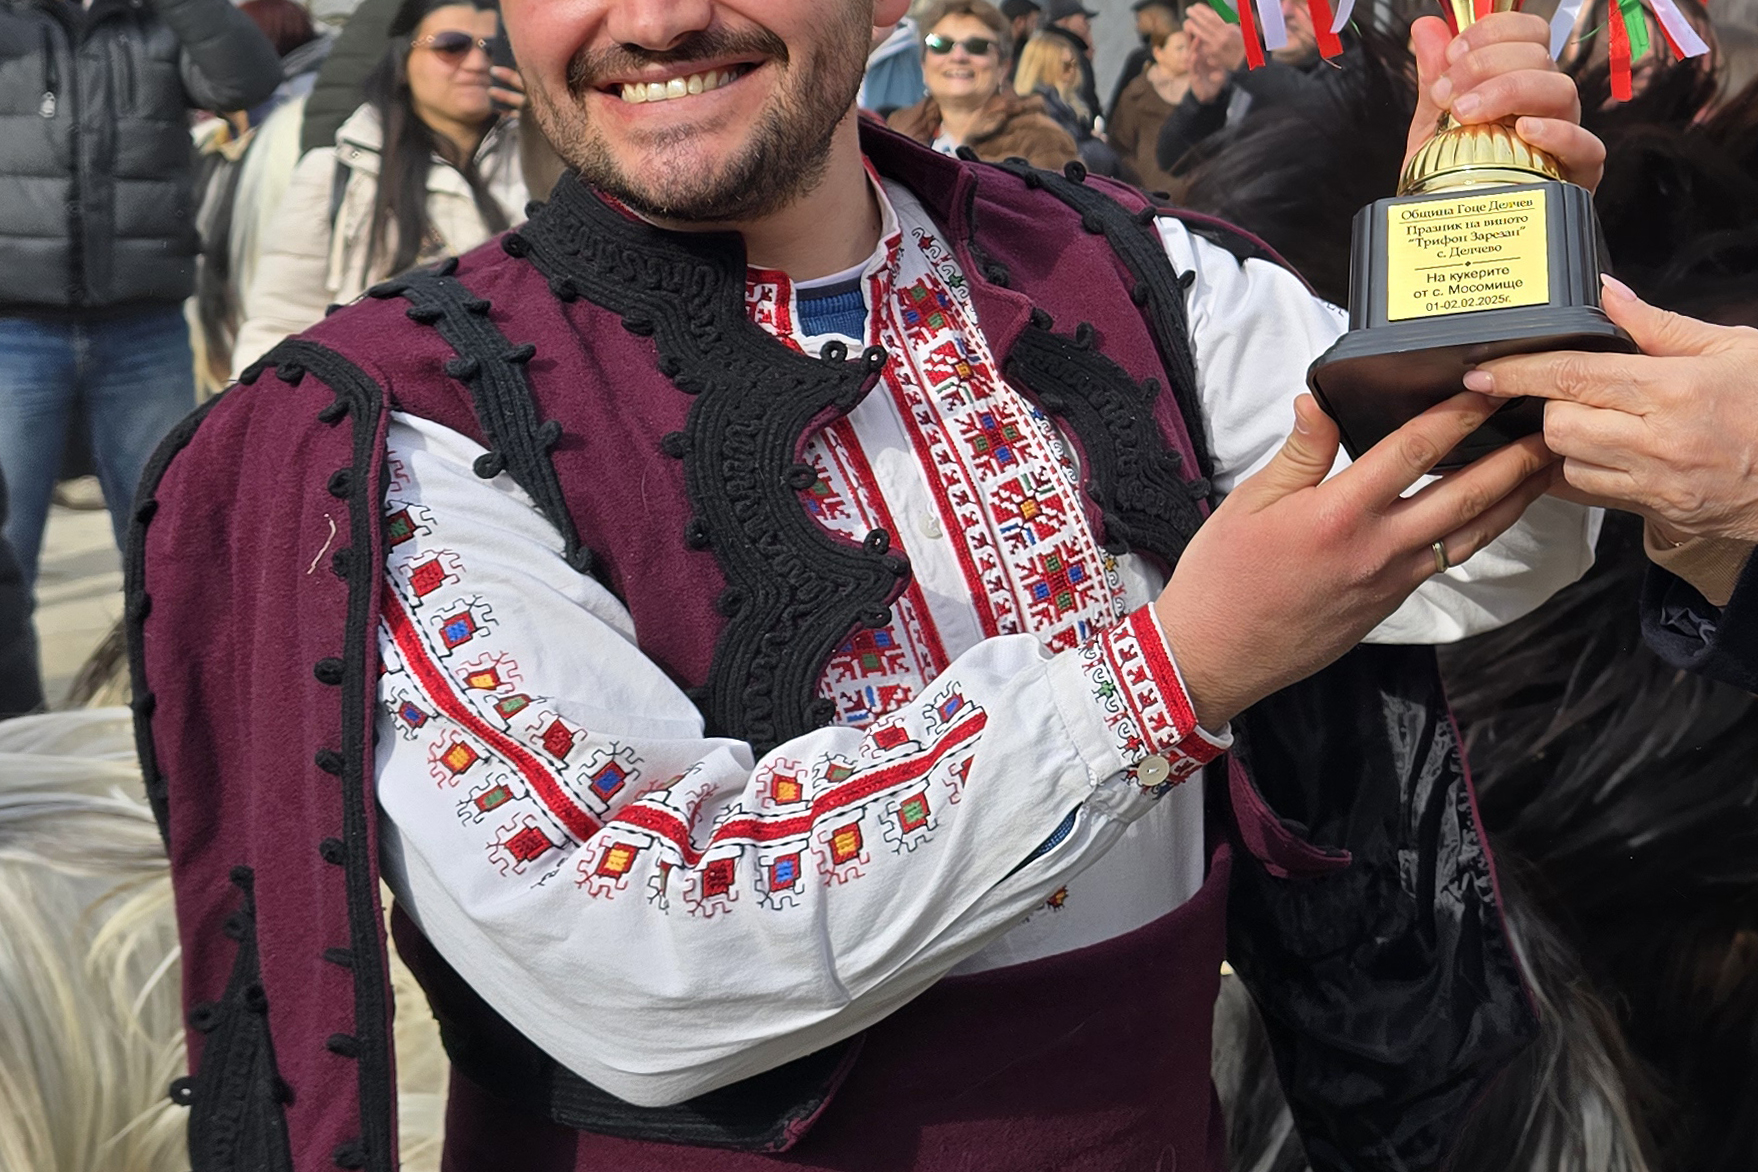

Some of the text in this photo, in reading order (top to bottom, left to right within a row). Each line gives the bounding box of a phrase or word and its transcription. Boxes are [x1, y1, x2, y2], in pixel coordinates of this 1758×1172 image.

[1401, 199, 1533, 220] Община Гоце Делчев
[1406, 215, 1529, 236] Празник на виното
[1436, 244, 1502, 258] с. Делчево
[1426, 266, 1510, 283] На кукерите
[1413, 279, 1524, 299] от с. Мосомище
[1425, 293, 1512, 312] 01-02.02.2025г.
